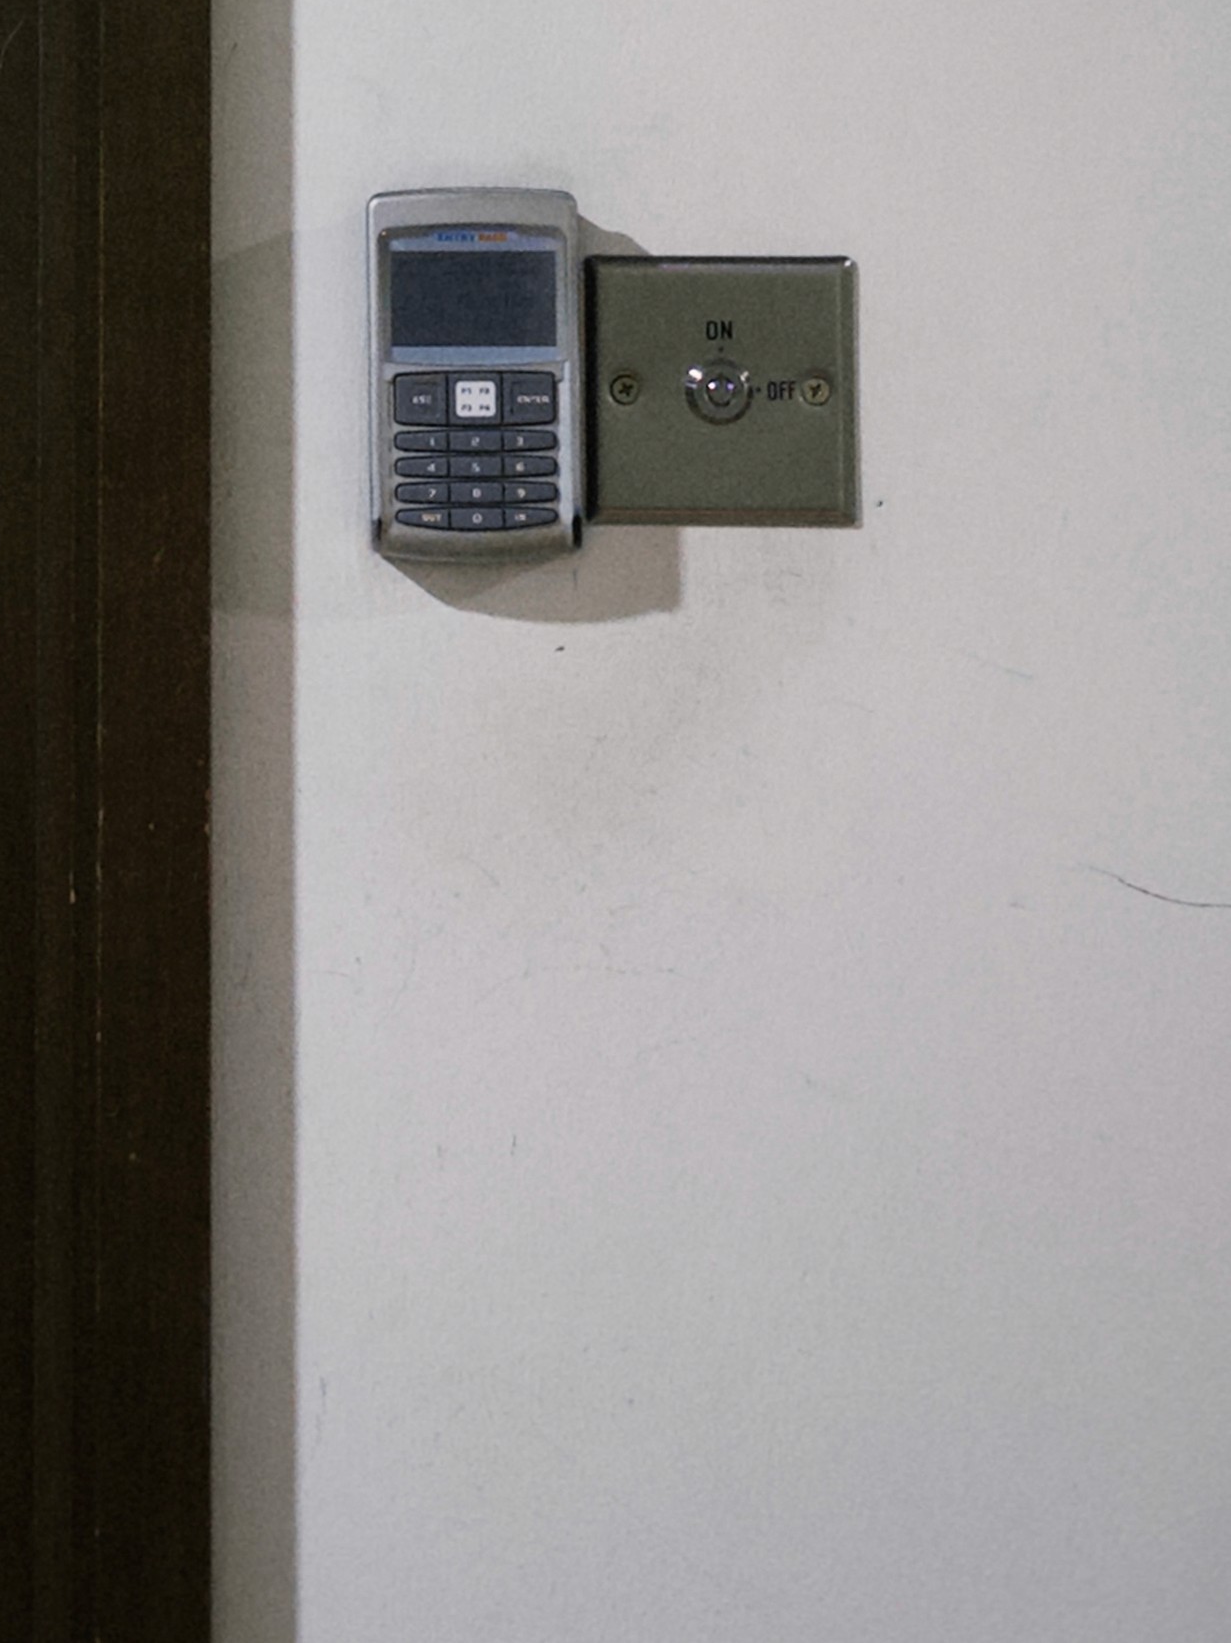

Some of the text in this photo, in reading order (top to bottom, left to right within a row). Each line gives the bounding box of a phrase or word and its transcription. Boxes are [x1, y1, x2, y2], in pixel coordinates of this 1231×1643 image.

[705, 320, 733, 340] ON
[767, 381, 797, 400] OFF
[470, 436, 480, 446] 2
[516, 436, 524, 446] 3
[426, 462, 436, 472] 4
[471, 462, 481, 472] 5
[515, 462, 525, 472] 6
[428, 488, 437, 498] 7
[472, 488, 482, 498] 8
[516, 488, 526, 499] 9
[472, 513, 483, 524] 0
